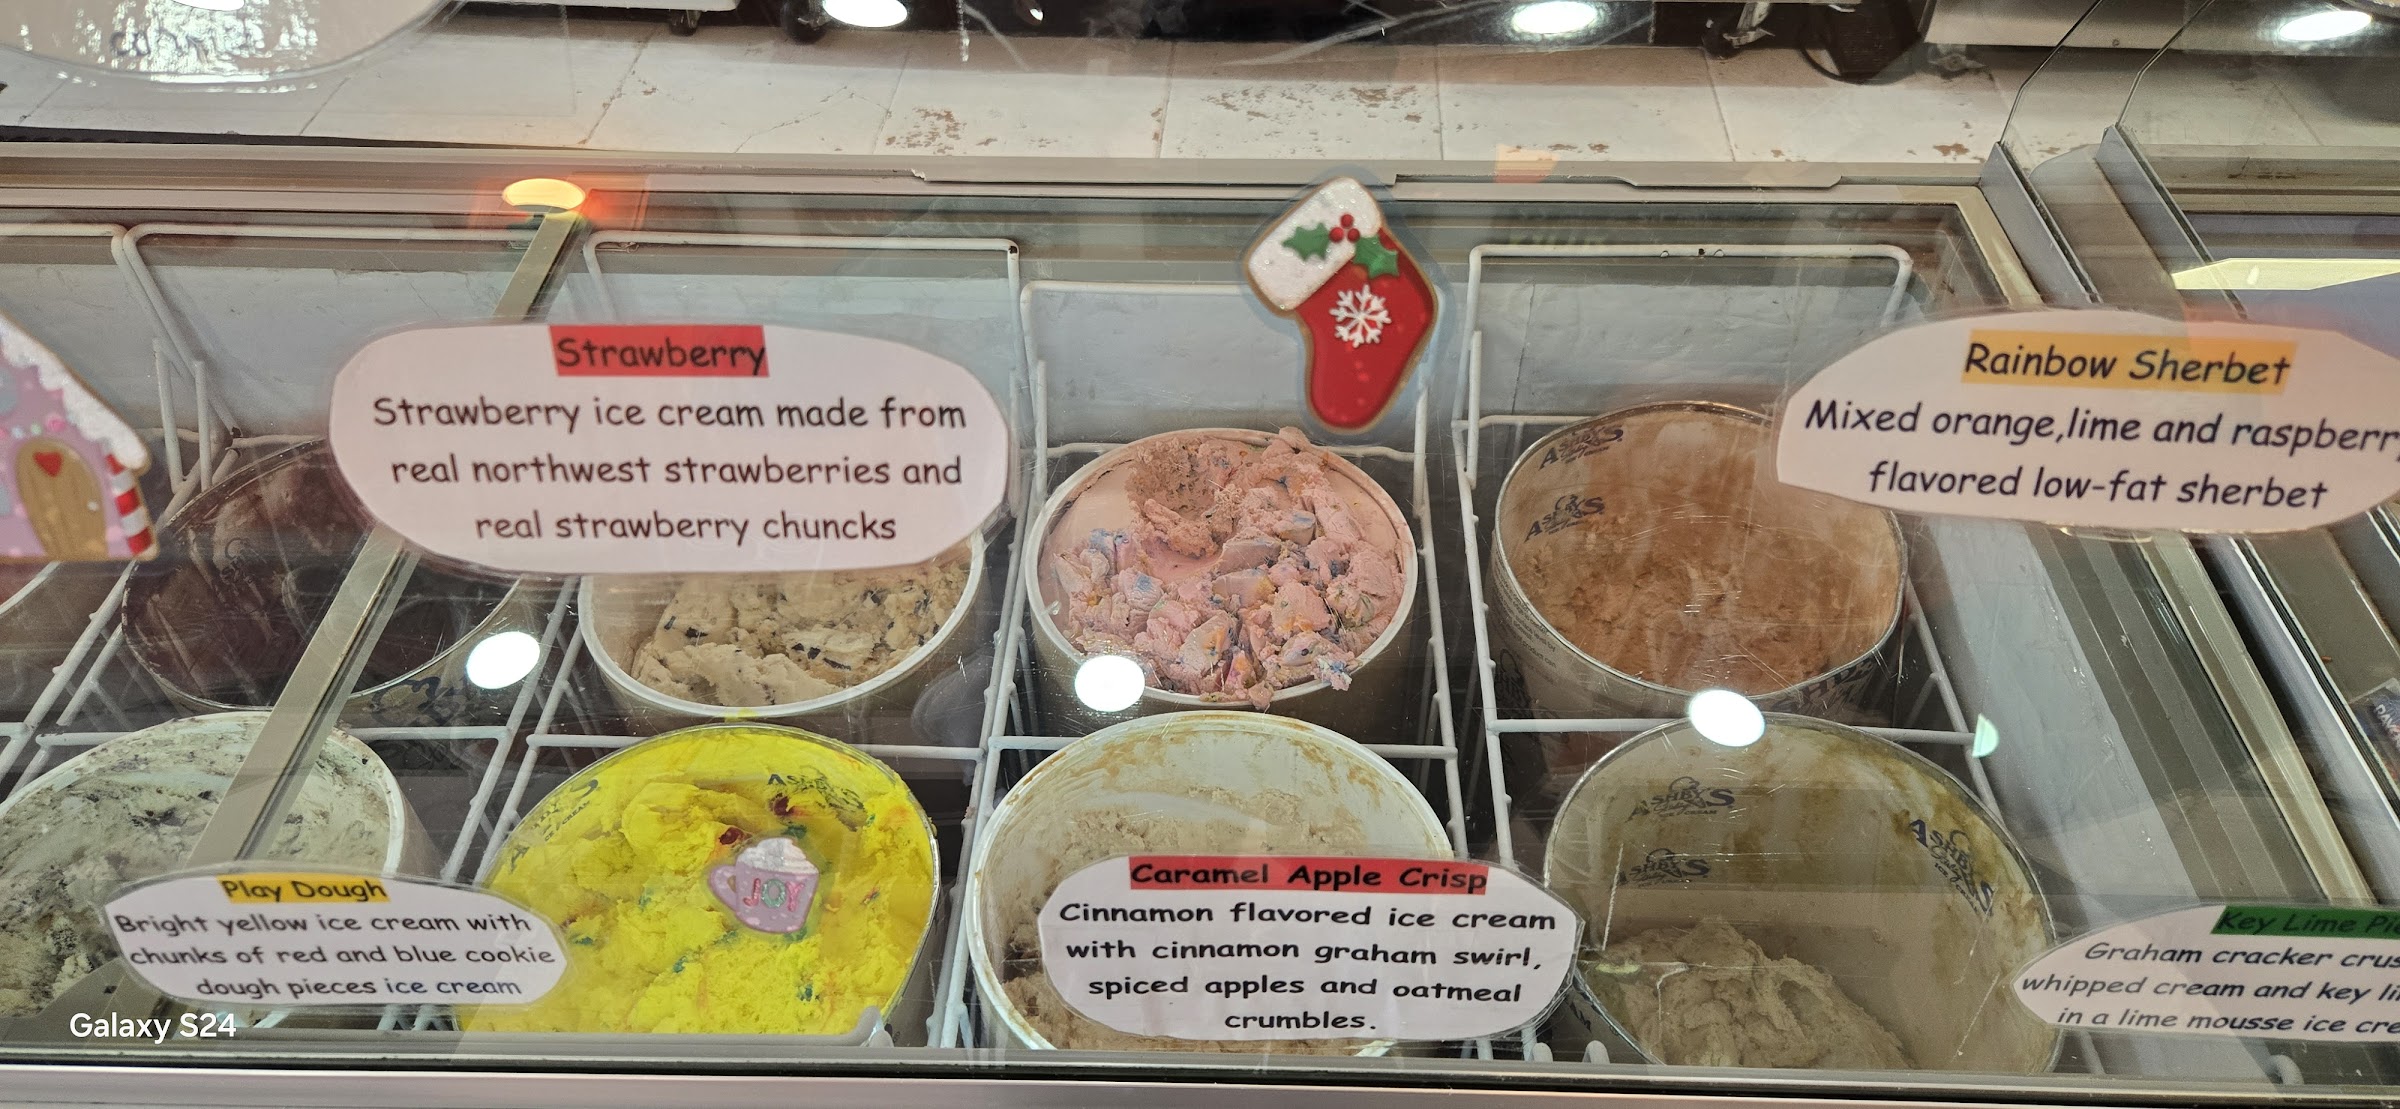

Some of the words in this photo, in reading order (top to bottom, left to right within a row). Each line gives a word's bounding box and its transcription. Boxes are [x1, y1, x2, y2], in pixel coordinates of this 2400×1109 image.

[556, 337, 766, 376] Strawberry
[1964, 342, 2118, 379] Rainbow
[2128, 348, 2291, 385] Sherbet
[373, 394, 580, 434] Strawberry
[593, 397, 645, 425] ice
[658, 404, 765, 427] cream
[777, 397, 869, 428] made
[881, 396, 967, 428] from
[1805, 399, 1922, 432] Mixed
[2153, 412, 2223, 444] and
[2231, 418, 2400, 462] raspberr
[391, 453, 458, 484] real
[473, 453, 651, 483] northwest
[665, 454, 890, 486] strawberries
[903, 455, 963, 485] and
[1869, 460, 2023, 496] flavored
[2033, 466, 2167, 502] low-fat
[2177, 473, 2328, 509] sherbet
[476, 510, 542, 540] real
[556, 510, 750, 547] strawberry
[762, 510, 897, 540] chuncks
[221, 880, 282, 902] Play
[291, 880, 388, 902] Dough
[1131, 863, 1269, 884] Caramel
[1286, 865, 1382, 891] Apple
[1399, 867, 1488, 894] Crisp
[743, 877, 805, 912] JOY
[114, 914, 209, 937] Bright
[217, 914, 308, 936] yellow
[316, 914, 362, 931] ice
[371, 917, 460, 931] cream
[466, 913, 532, 931] with
[1059, 903, 1214, 922] Cinnamon
[1229, 902, 1372, 925] flavored
[1388, 907, 1435, 927] ice
[1452, 912, 1556, 930] cream
[2215, 912, 2279, 936] Key
[2283, 912, 2357, 933] Lime
[130, 947, 227, 965] chunks
[236, 946, 265, 964] of
[276, 946, 328, 963] red
[336, 945, 388, 963] and
[393, 944, 456, 963] blue
[465, 945, 556, 963] cookie
[1066, 940, 1137, 958] with
[1152, 941, 1300, 959] cinnamon
[1314, 944, 1437, 964] graham
[1453, 947, 1542, 970] swirl,
[2083, 941, 2202, 963] Graham
[2212, 947, 2333, 967] cracker
[196, 978, 280, 1000] dough
[286, 978, 377, 1000] pieces
[383, 978, 428, 994] ice
[436, 980, 522, 995] cream
[1088, 976, 1189, 1000] spiced
[1204, 975, 1305, 999] apples
[1320, 978, 1378, 995] and
[1392, 983, 1521, 1002] oatmeal
[2021, 973, 2148, 999] whipped
[2152, 979, 2245, 997] cream
[2253, 981, 2312, 1000] and
[2315, 981, 2372, 1005] key
[1224, 1011, 1376, 1030] crumbles.
[2057, 1007, 2083, 1025] in
[2091, 1012, 2110, 1026] a
[2117, 1008, 2178, 1028] lime
[2186, 1013, 2294, 1032] mousse
[2303, 1014, 2347, 1033] ice
